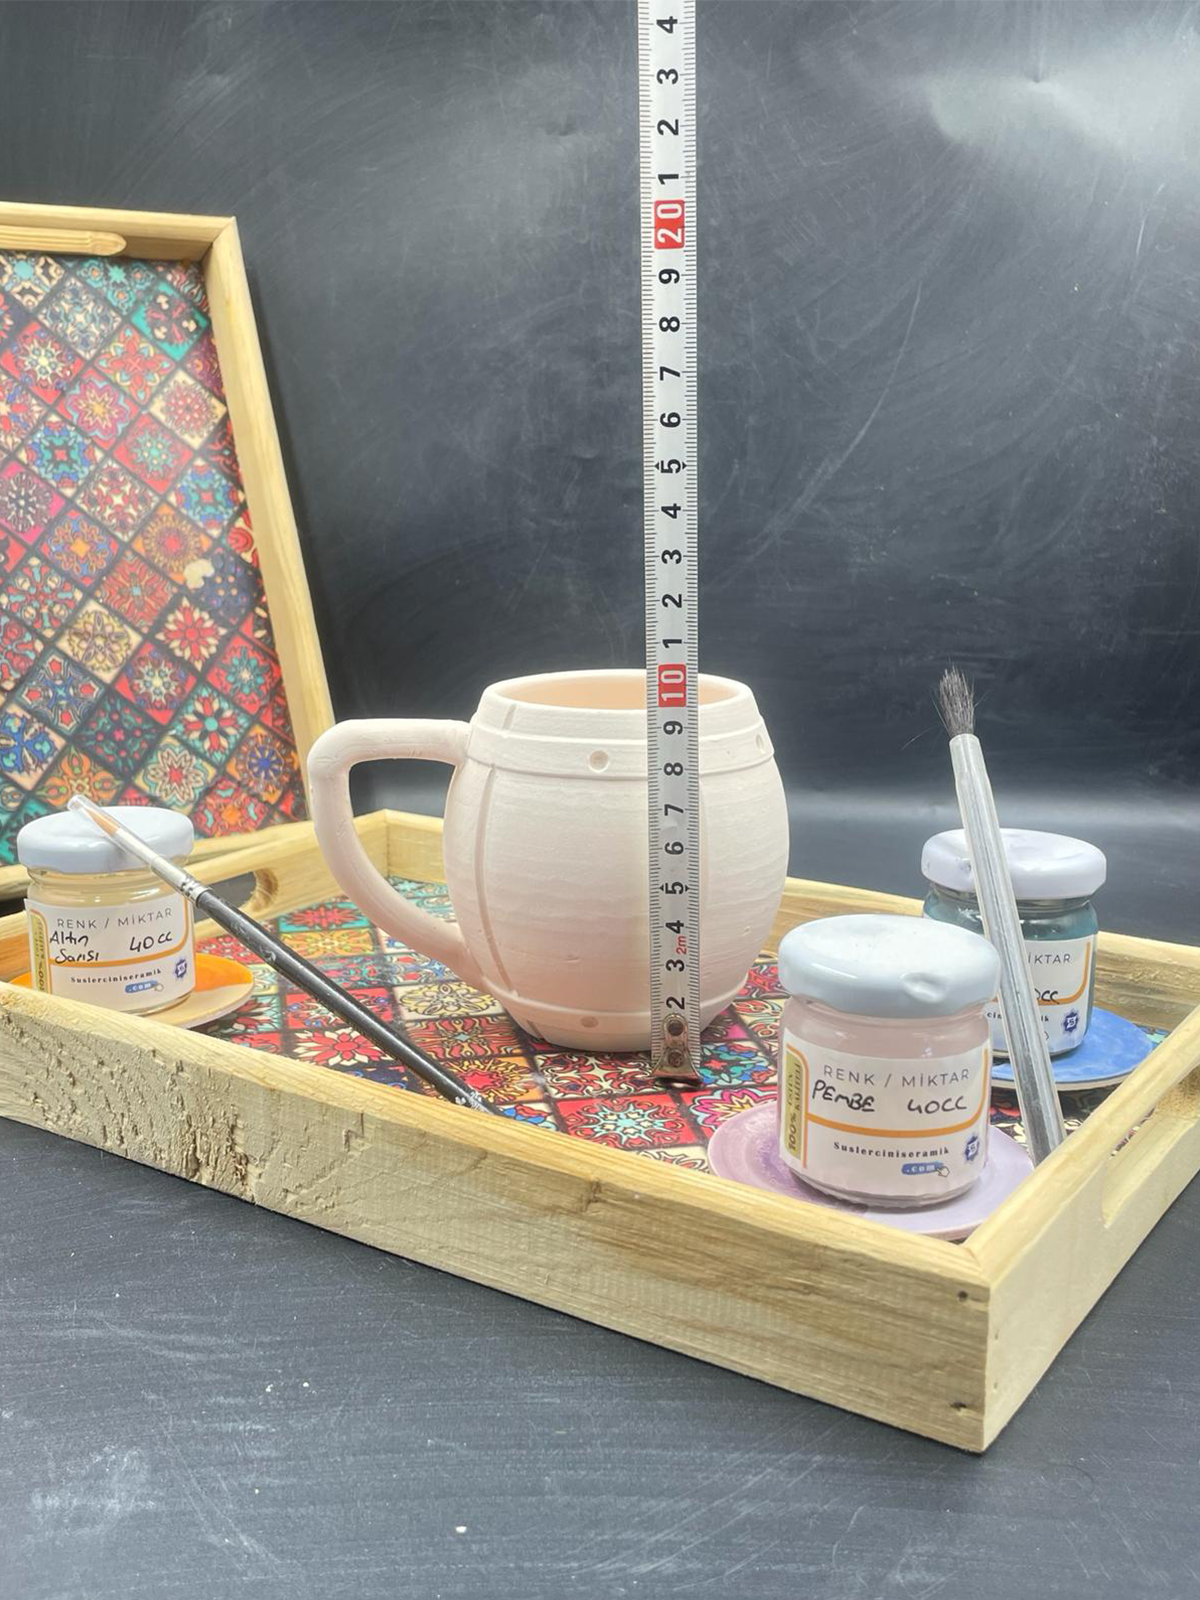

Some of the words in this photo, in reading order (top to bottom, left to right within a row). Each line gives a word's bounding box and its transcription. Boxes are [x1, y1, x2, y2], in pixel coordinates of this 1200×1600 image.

[656, 16, 678, 34] 4
[656, 68, 679, 84] 3
[657, 118, 679, 136] 2
[657, 173, 680, 185] 1
[656, 203, 683, 244] 20
[658, 268, 680, 284] 9
[658, 316, 681, 333] 8
[659, 366, 681, 381] 7
[659, 412, 682, 428] 6
[660, 458, 682, 474] 5
[660, 503, 682, 519] 4
[661, 549, 683, 565] 3
[661, 593, 683, 608] 2
[662, 638, 683, 649] 1
[660, 669, 685, 702] 10
[663, 720, 683, 735] 9
[663, 762, 684, 777] 8
[664, 803, 684, 816] 7
[664, 841, 684, 855] 6
[665, 881, 684, 895] 5
[57, 918, 98, 930] RENK
[665, 919, 685, 934] 4
[675, 935, 687, 955] 2m
[665, 959, 685, 972] 3
[1027, 952, 1072, 965] İKTAR
[666, 996, 685, 1010] 2
[823, 1065, 876, 1087] RENK
